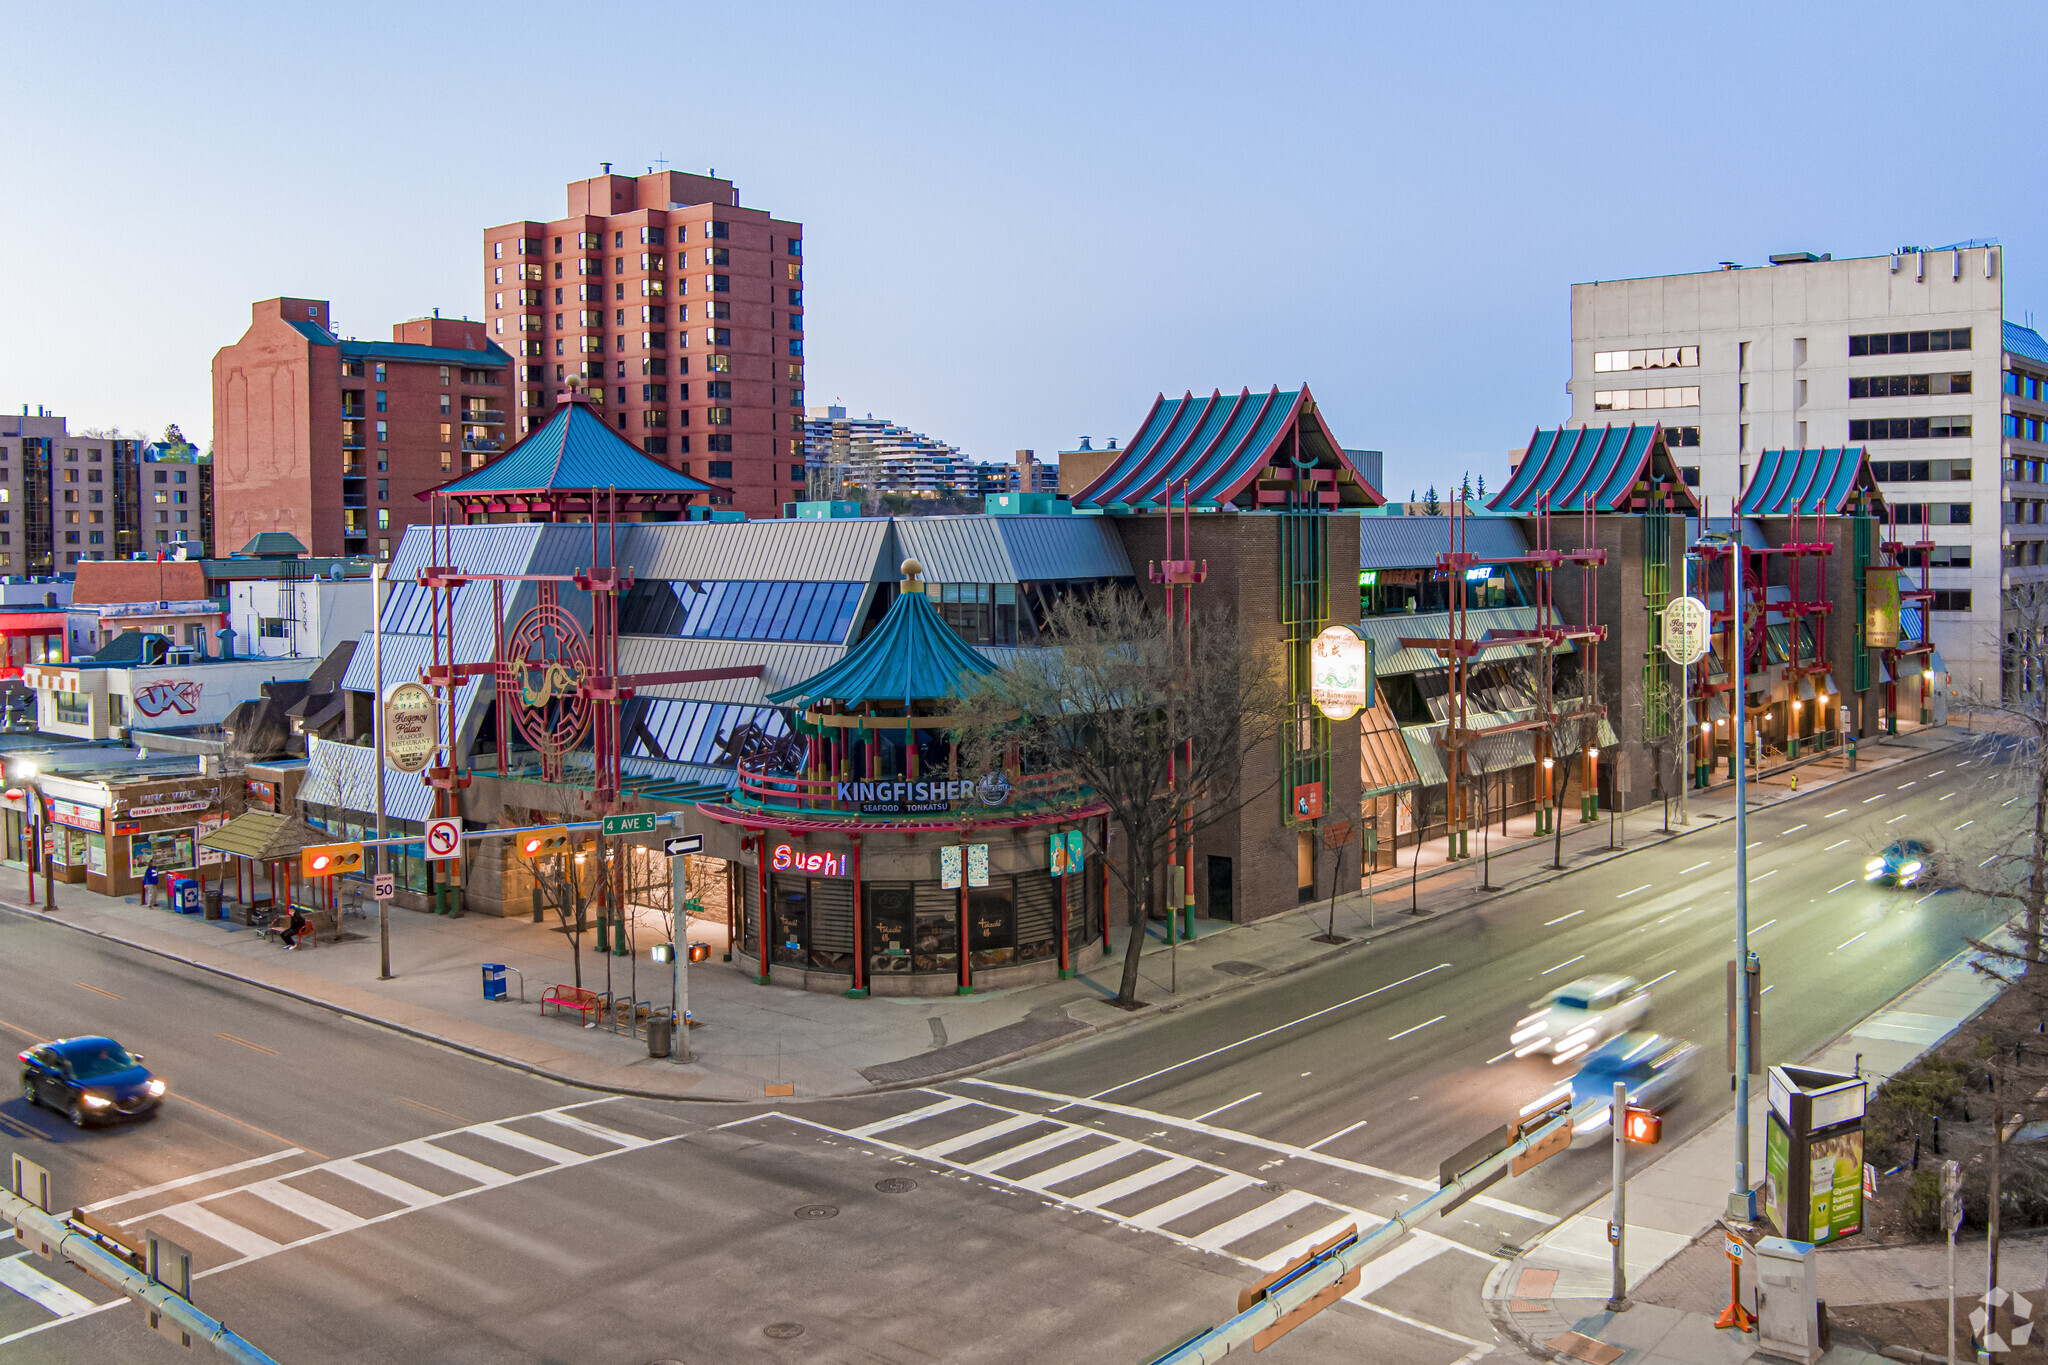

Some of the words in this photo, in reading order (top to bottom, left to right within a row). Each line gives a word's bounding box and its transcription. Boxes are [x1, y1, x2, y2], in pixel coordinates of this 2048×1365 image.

[392, 711, 428, 725] Regency
[396, 722, 422, 734] Palace
[391, 738, 431, 748] RESTAURANT
[837, 780, 974, 801] KINGFISHER
[173, 802, 207, 811] IMPORTS
[863, 804, 899, 812] SEAFOOD
[906, 803, 948, 812] TONKATSU
[606, 820, 614, 831] 4
[620, 817, 640, 830] AVE
[646, 816, 653, 828] S
[772, 843, 847, 876] Sushi
[376, 883, 393, 896] 50
[1832, 1193, 1854, 1205] Eczema
[1832, 1199, 1855, 1212] Control
